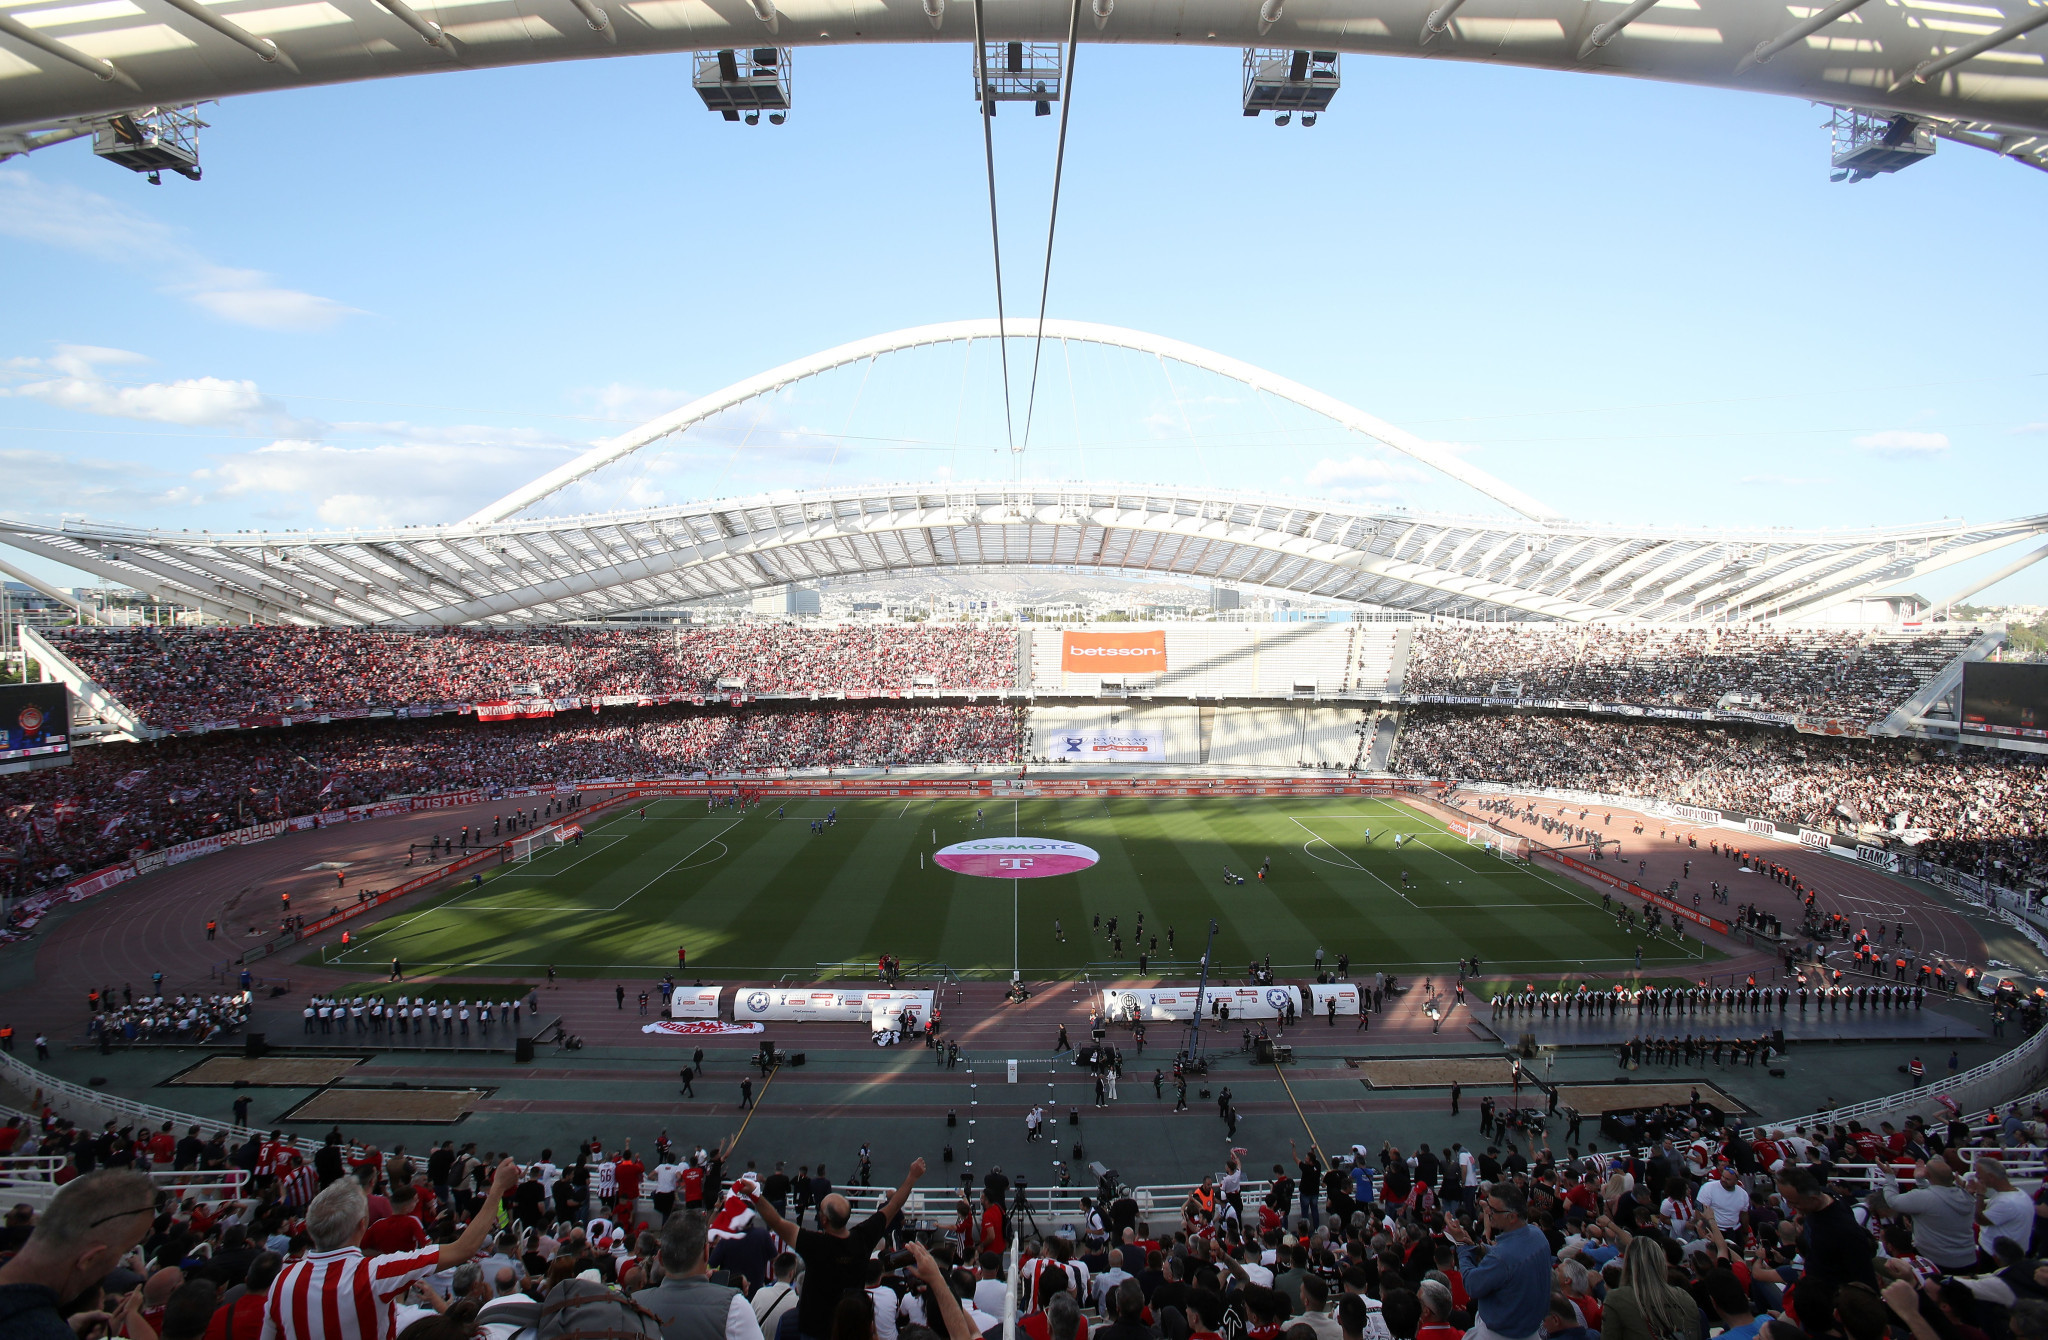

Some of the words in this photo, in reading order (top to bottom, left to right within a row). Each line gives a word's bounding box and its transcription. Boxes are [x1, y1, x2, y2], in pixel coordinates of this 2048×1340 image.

[1070, 645, 1156, 656] betsson
[640, 789, 673, 797] betsson
[1361, 787, 1393, 795] betsson
[1676, 806, 1719, 823] SUPPORT
[1747, 819, 1773, 834] YOUR
[1800, 830, 1831, 848] LOCAL
[1856, 846, 1884, 864] TEAM
[600, 1169, 612, 1183] 66
